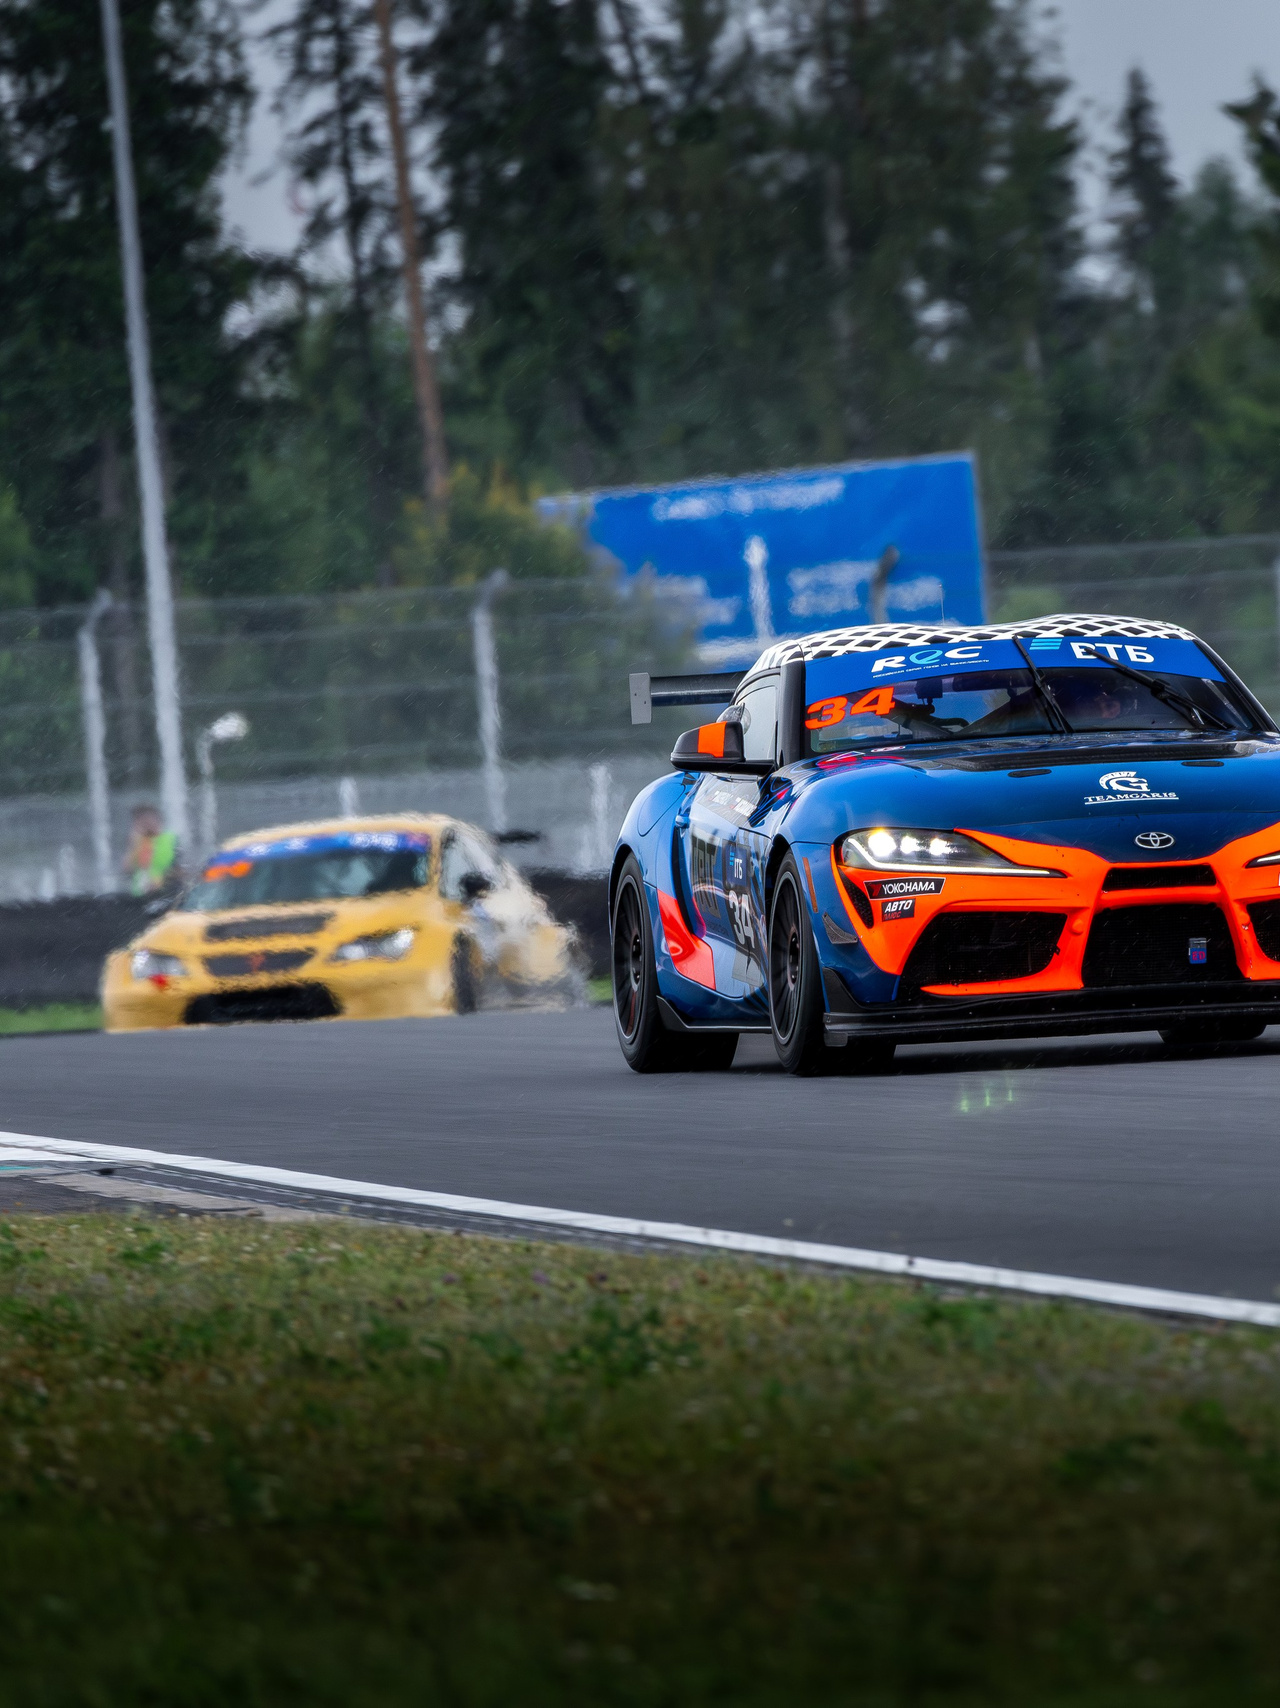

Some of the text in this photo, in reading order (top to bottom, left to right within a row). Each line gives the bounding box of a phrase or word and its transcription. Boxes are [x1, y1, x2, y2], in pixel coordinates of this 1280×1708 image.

[1070, 642, 1155, 663] ВТБ
[804, 686, 896, 730] 34
[1083, 792, 1177, 803] TEAMGARIS
[882, 881, 935, 895] YOKOHAMA
[884, 899, 913, 913] АВТО
[729, 890, 756, 949] 34
